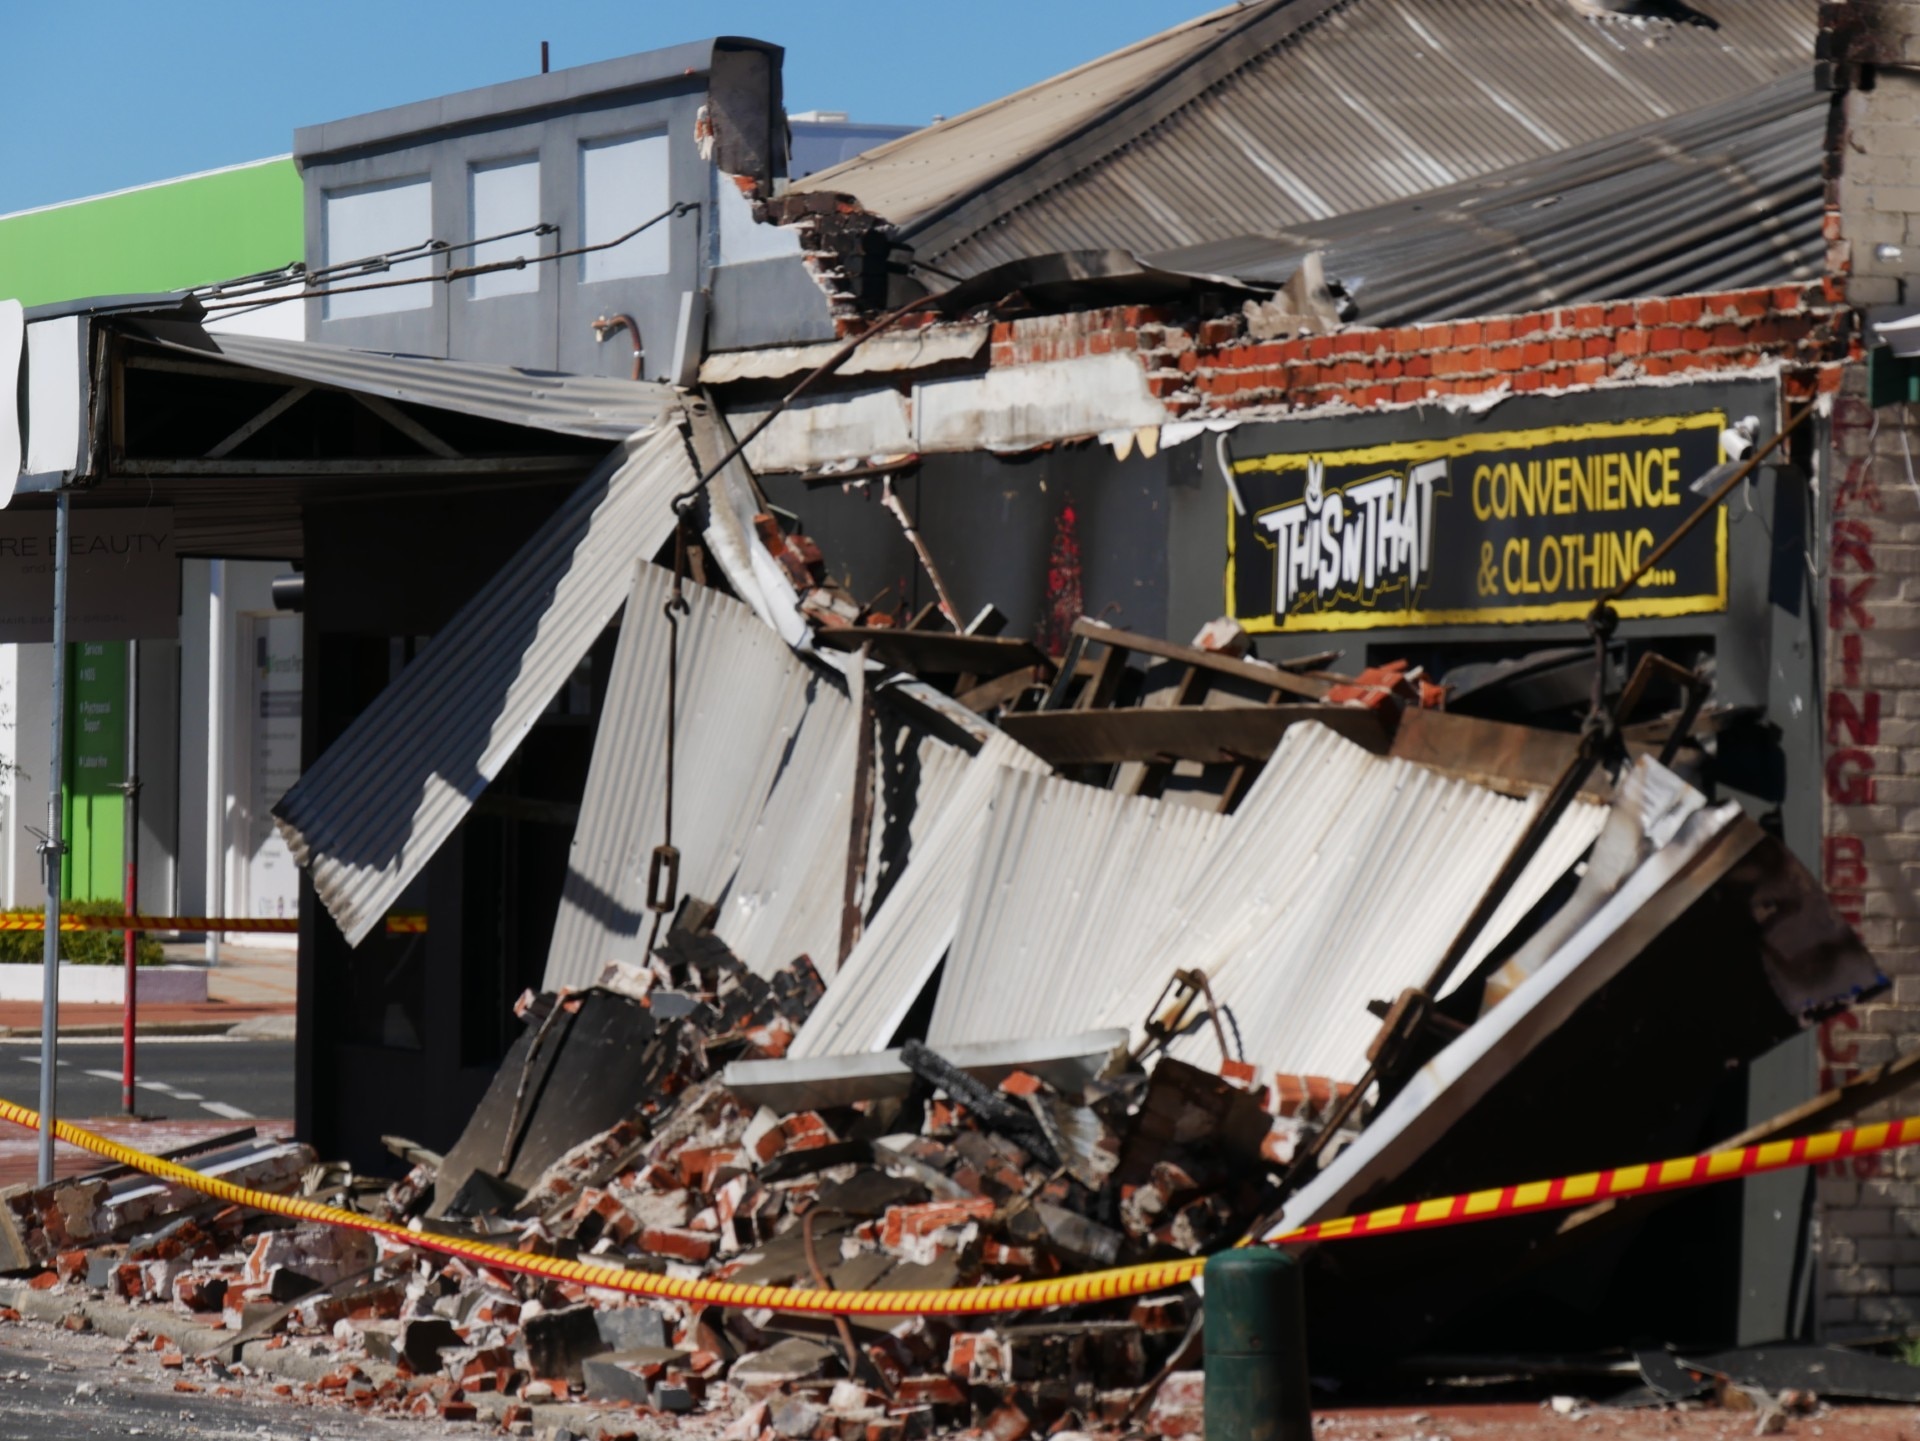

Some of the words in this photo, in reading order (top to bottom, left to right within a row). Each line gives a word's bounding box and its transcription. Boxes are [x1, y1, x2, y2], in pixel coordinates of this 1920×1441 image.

[1472, 446, 1680, 521] CONVENIENCE
[1477, 540, 1499, 597] &
[1826, 397, 1882, 804] PARKING
